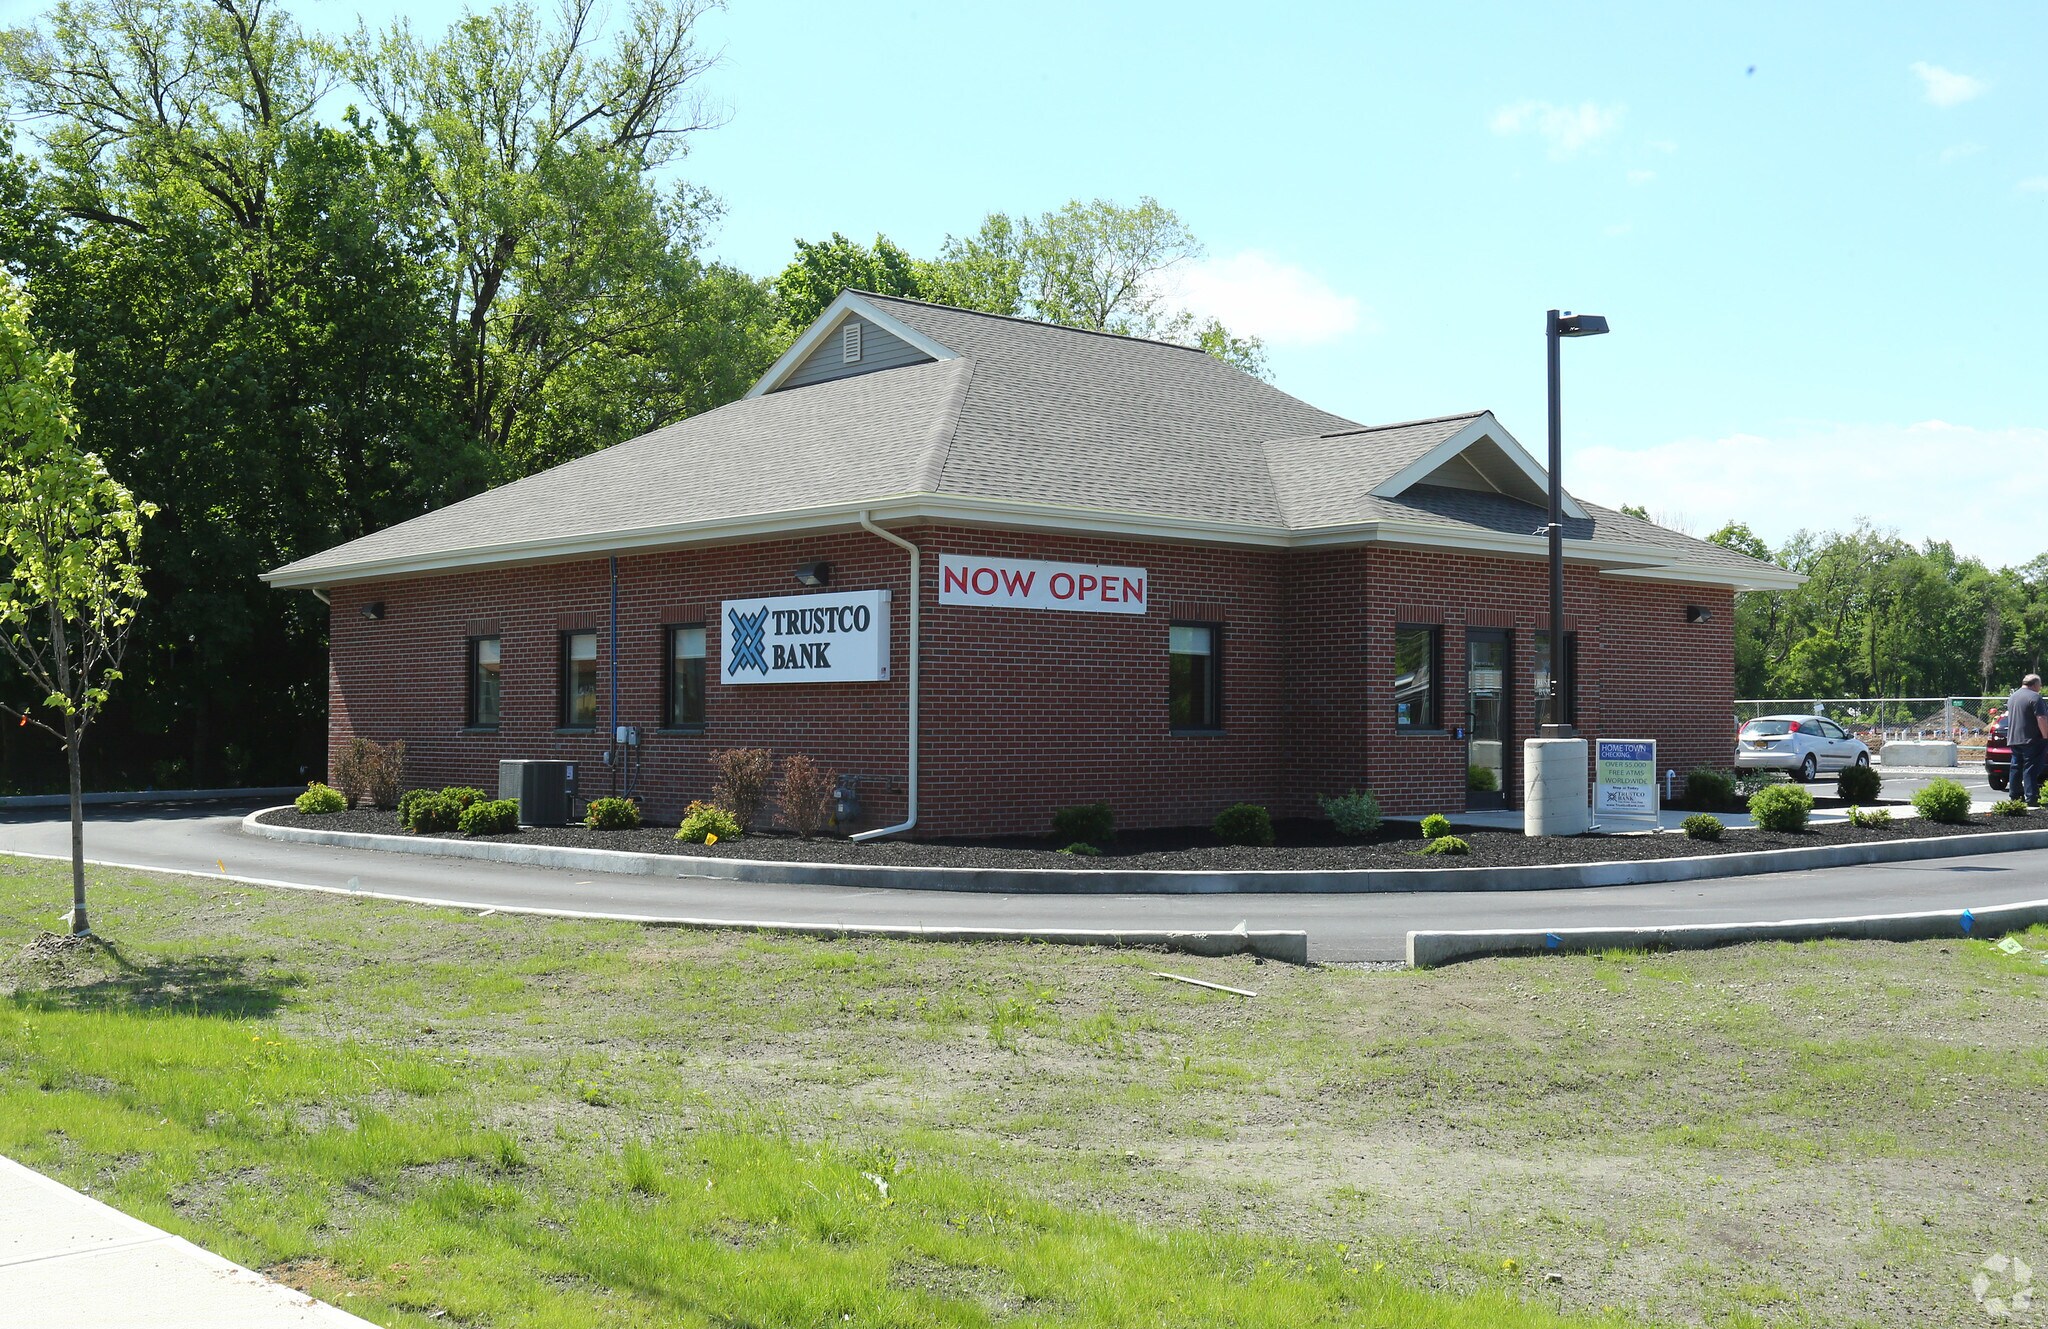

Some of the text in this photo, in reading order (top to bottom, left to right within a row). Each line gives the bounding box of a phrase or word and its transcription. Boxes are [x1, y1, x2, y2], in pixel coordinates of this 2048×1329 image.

[944, 565, 1143, 604] NOW OPEN
[772, 605, 871, 636] TRUSTCO
[772, 642, 832, 670] BANK
